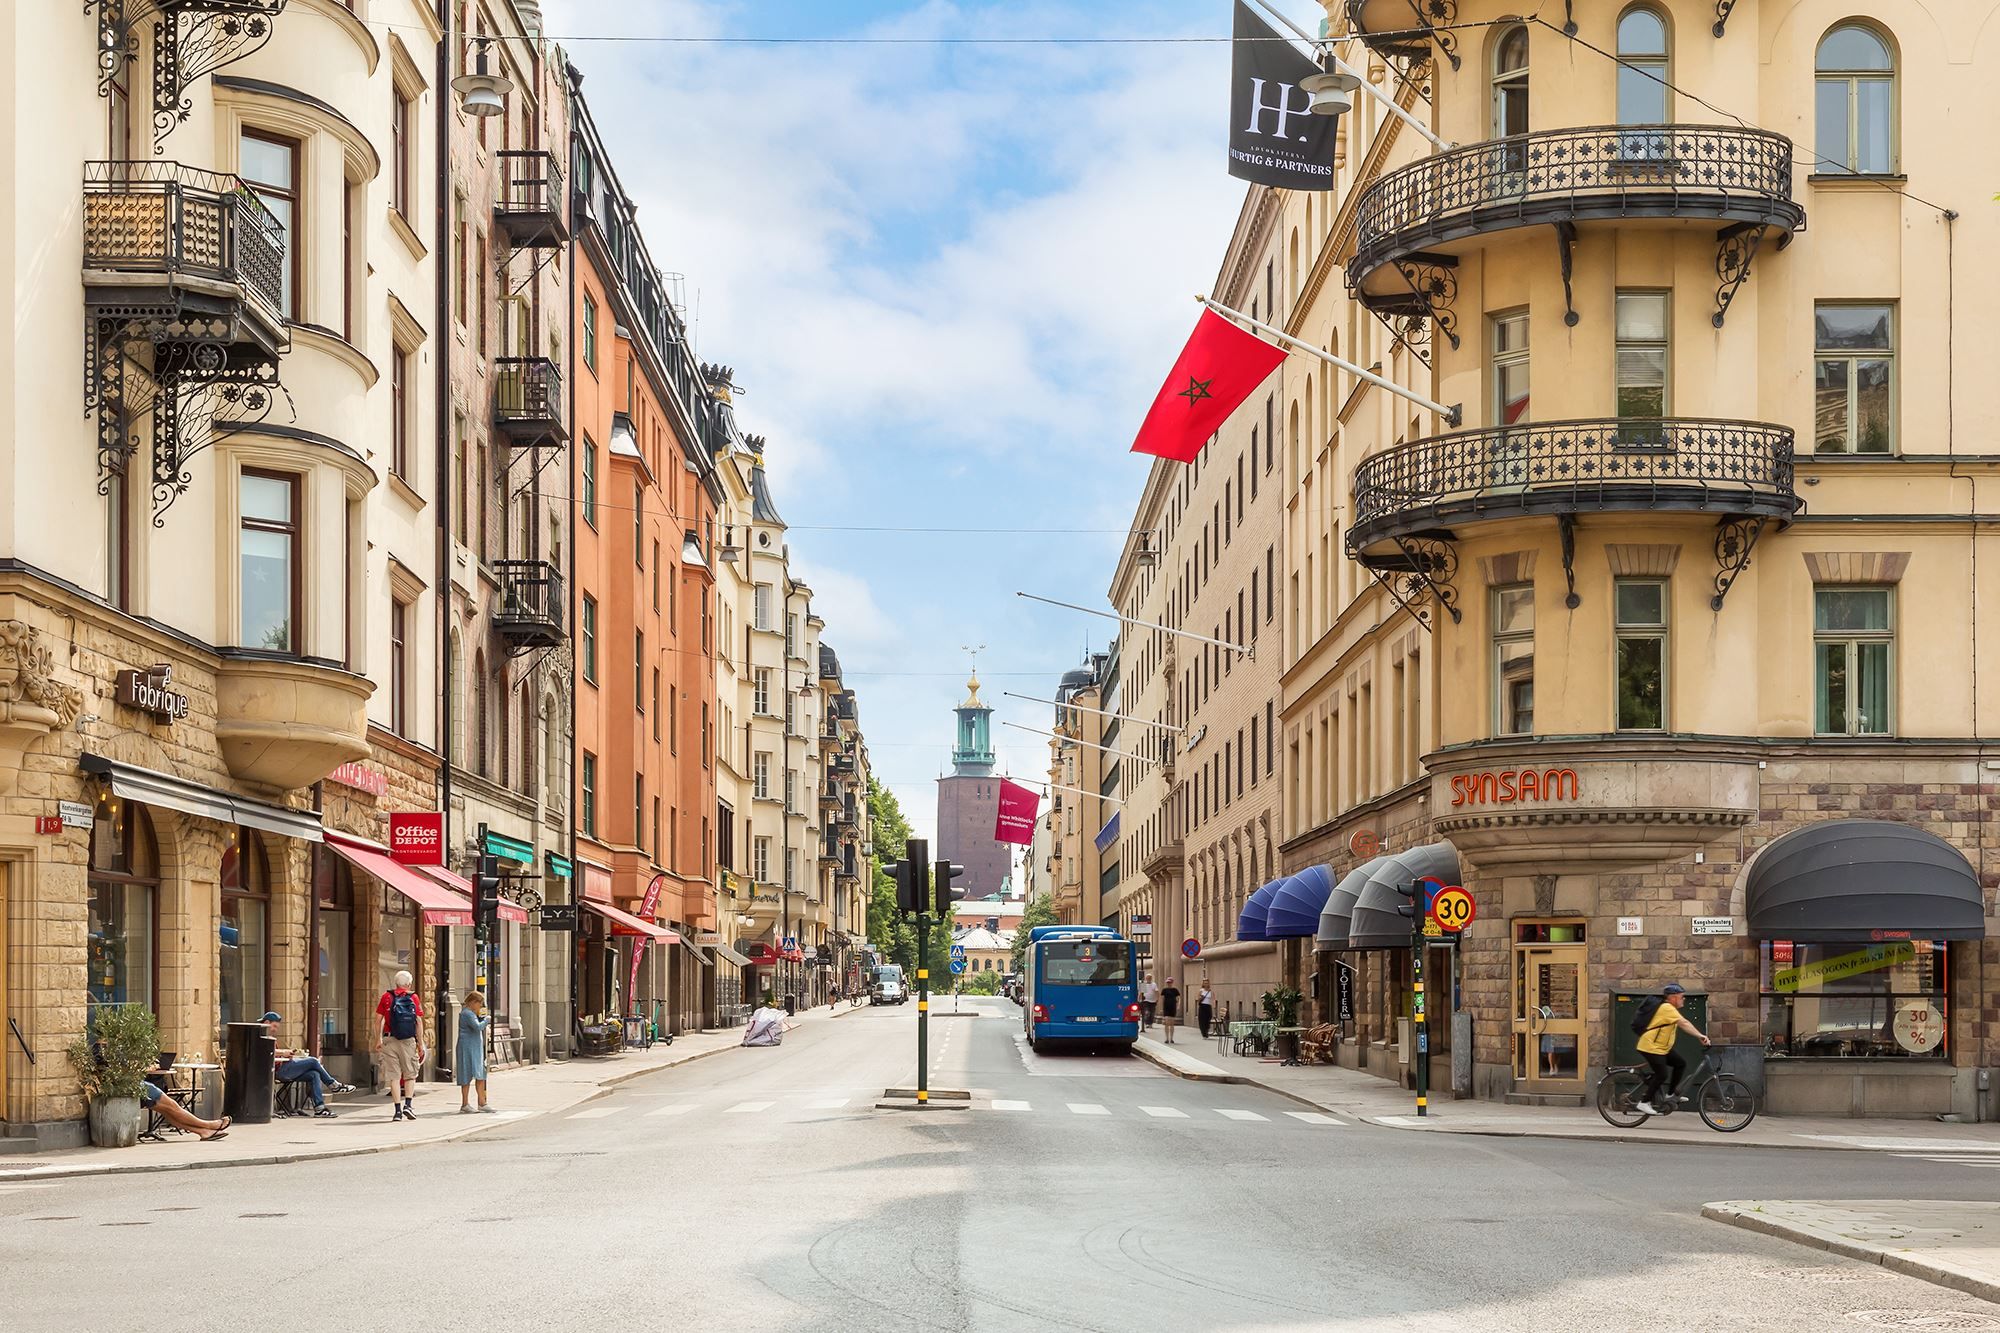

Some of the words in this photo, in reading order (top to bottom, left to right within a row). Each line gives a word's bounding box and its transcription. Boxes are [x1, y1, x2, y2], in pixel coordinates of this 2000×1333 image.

[1250, 145, 1305, 160] ADVOKATERNA
[1229, 147, 1263, 165] HURTIG
[1265, 156, 1274, 167] &
[1275, 158, 1332, 176] PARTNERS
[132, 665, 188, 724] Fabrique
[1450, 768, 1578, 806] SYNSAM
[1001, 820, 1028, 829] gymnasium
[1010, 816, 1033, 824] Whitlocks
[395, 826, 438, 837] Office
[395, 837, 437, 845] DEPOT
[541, 909, 575, 918] LYX
[1439, 898, 1470, 920] 30
[1693, 919, 1732, 927] Kungsholmstorg
[1084, 947, 1091, 957] 3
[1778, 975, 1798, 986] HYR
[1910, 1010, 1928, 1022] 30
[1910, 1031, 1926, 1045] %
